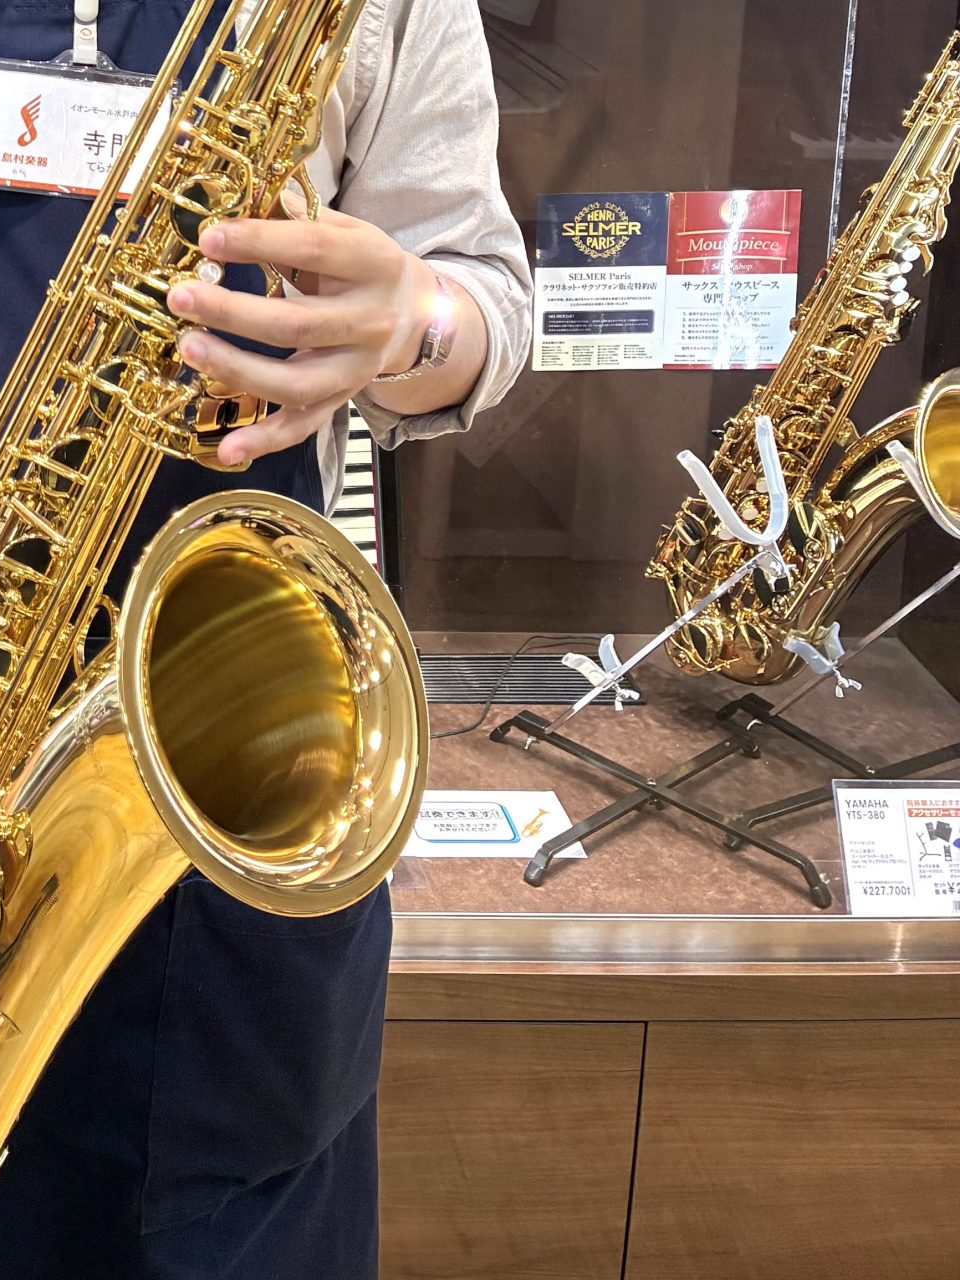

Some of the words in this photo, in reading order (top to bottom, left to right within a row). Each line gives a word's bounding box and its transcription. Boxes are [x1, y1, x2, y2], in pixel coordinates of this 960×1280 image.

[1, 152, 48, 168] 島村楽器
[587, 209, 616, 222] HENRI
[561, 221, 642, 236] SELMER
[586, 236, 616, 250] PARIS
[568, 272, 607, 281] SELMER
[609, 271, 632, 281] Paris
[682, 280, 780, 291] サックスウスピース
[844, 799, 889, 809] YAMAHA
[846, 810, 886, 820] YTS-380
